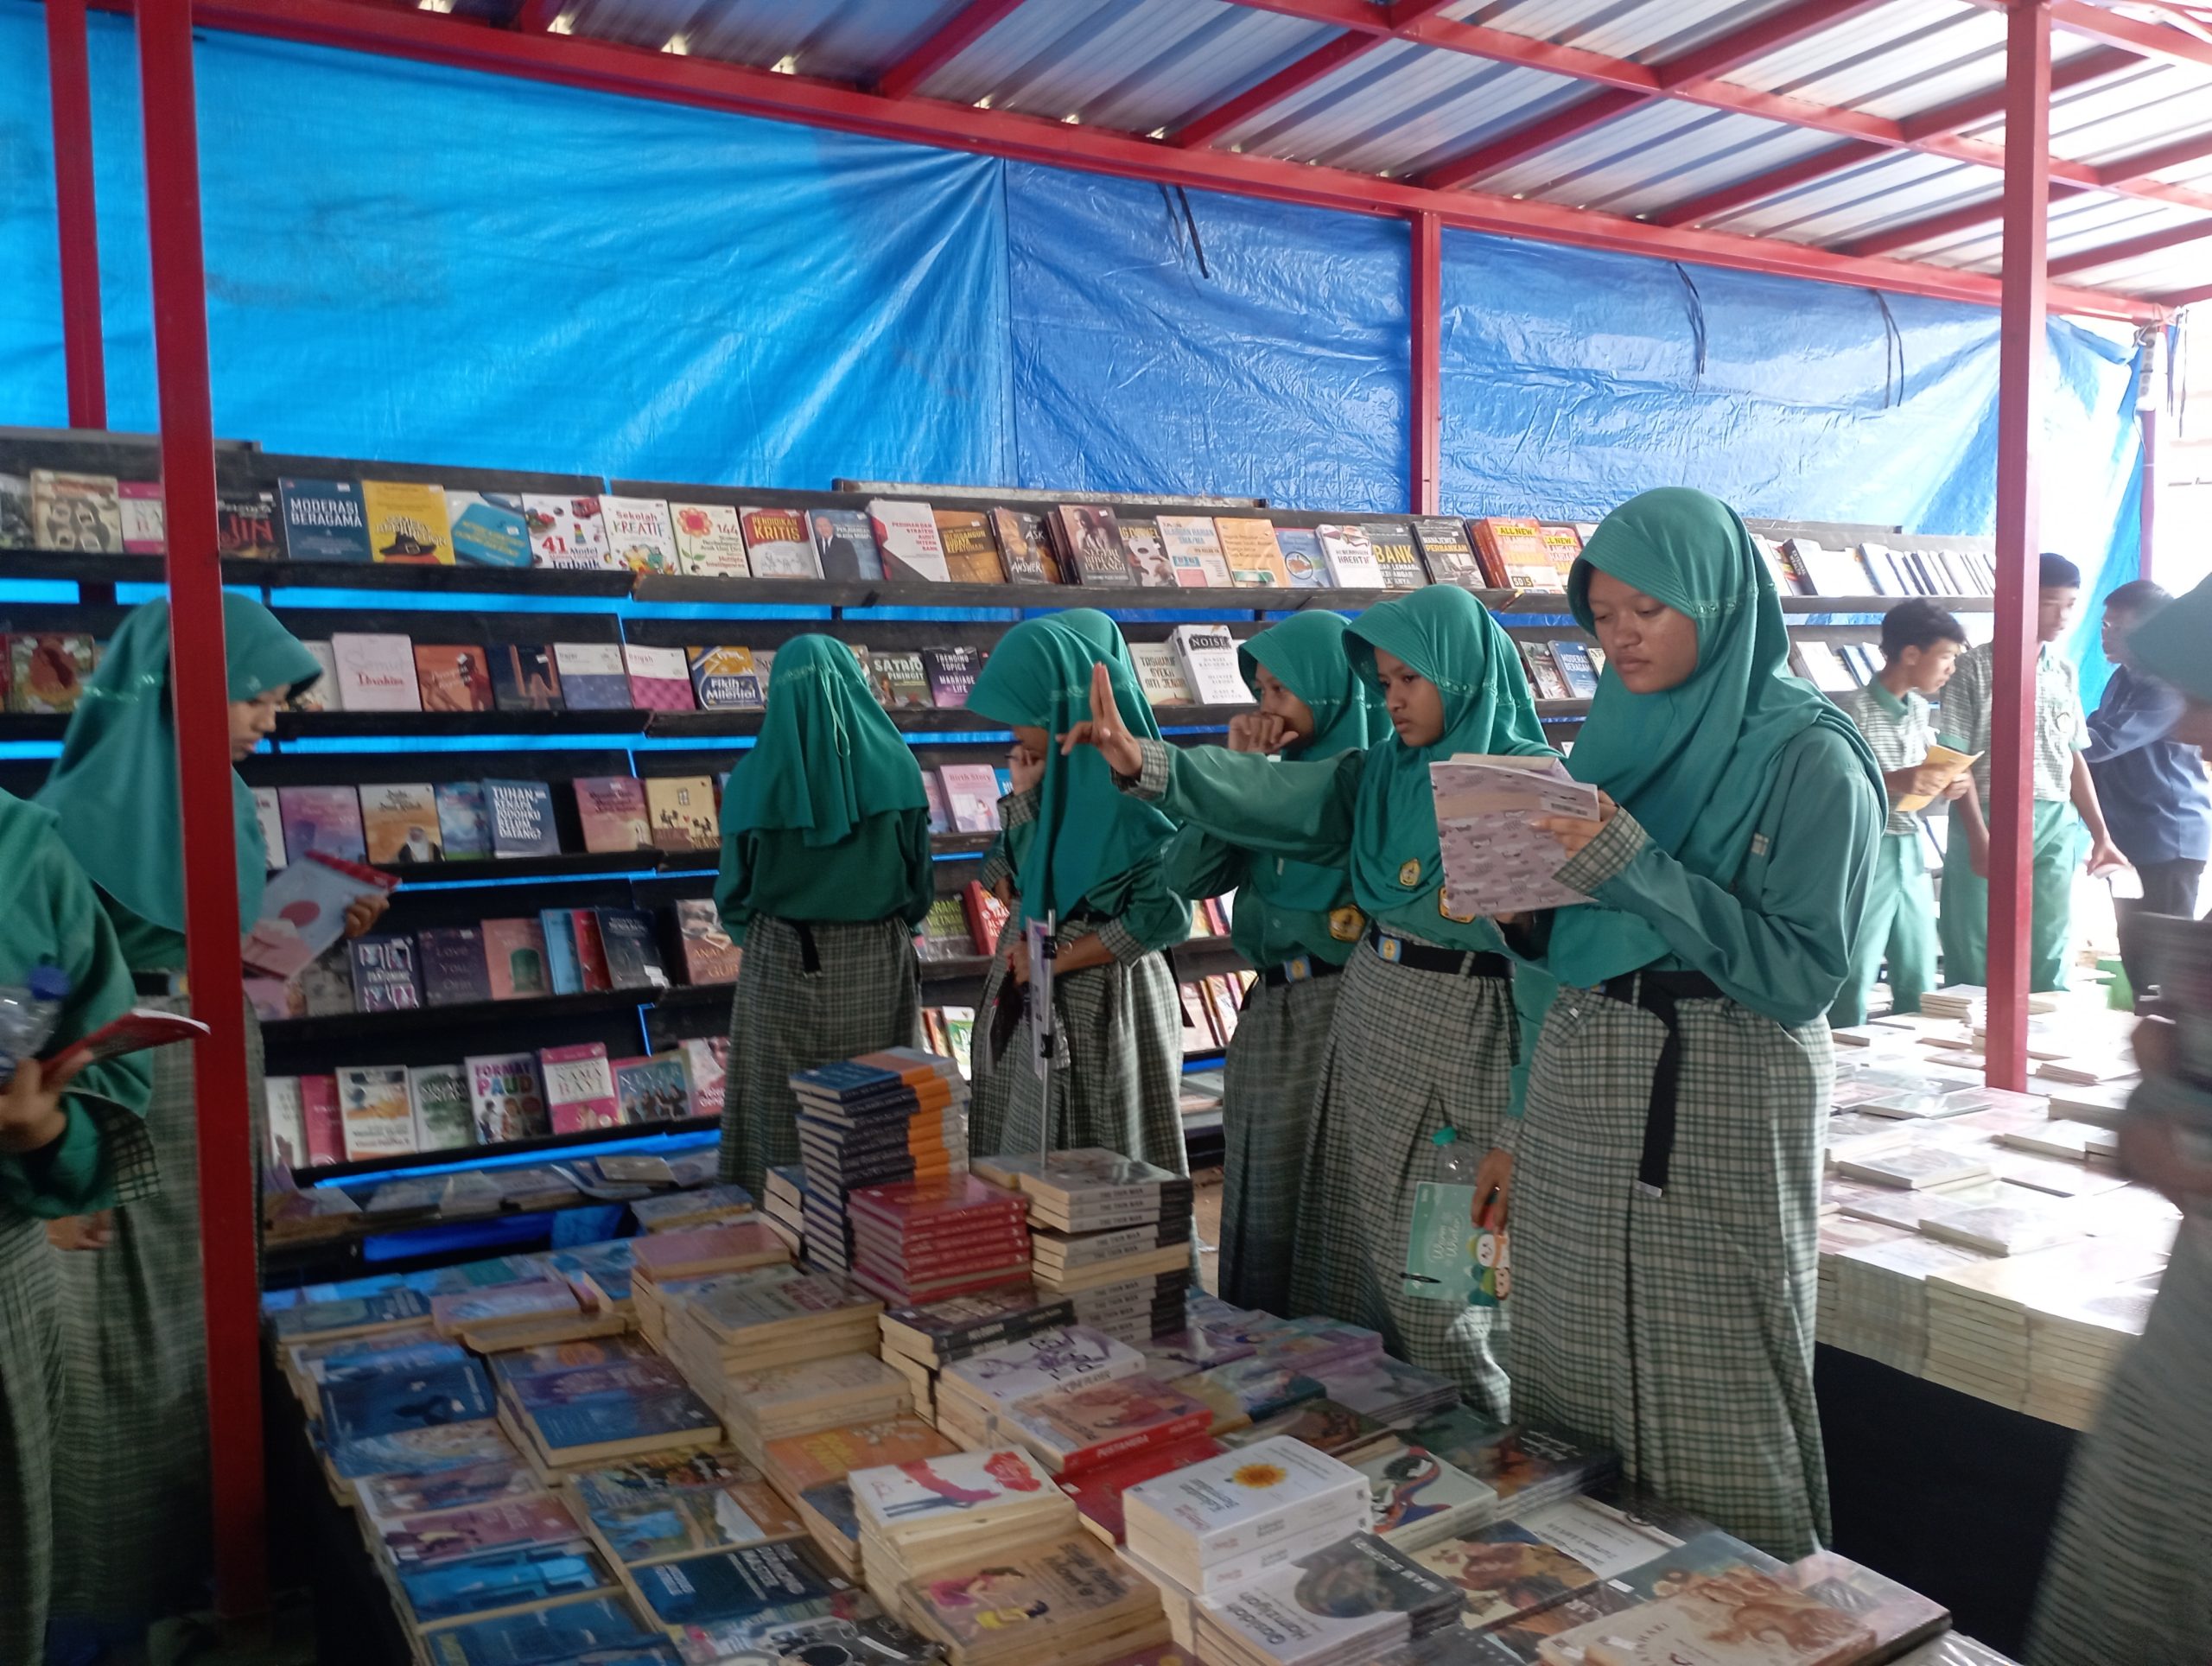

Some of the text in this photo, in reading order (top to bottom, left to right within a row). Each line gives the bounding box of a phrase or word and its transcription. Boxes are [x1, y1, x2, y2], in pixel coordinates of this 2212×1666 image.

[290, 498, 359, 514] MODERASI
[291, 512, 363, 528] BERAGAMA
[616, 510, 657, 521] Sekolah
[752, 516, 798, 525] PENDIDIKAN
[613, 520, 665, 537] KREATIF
[753, 525, 800, 541] KRITIS
[1500, 526, 1534, 536] ALL NEW
[542, 536, 568, 553] 41
[1422, 536, 1457, 544] MANAJEMEN
[1373, 544, 1415, 564] BANK
[1425, 544, 1469, 553] PERBANKAN
[1011, 562, 1043, 574] ANSWER
[1192, 636, 1230, 648] NOISE
[935, 653, 969, 664] TRENDING
[874, 658, 924, 672] SATRIO
[942, 662, 966, 671] TOPICS
[887, 672, 925, 681] PININGIT
[939, 675, 976, 685] MARRIAGE
[711, 677, 742, 690] Fikih
[952, 685, 969, 694] LIFE
[706, 688, 757, 701] Milenial
[492, 785, 538, 804] TUHAN,
